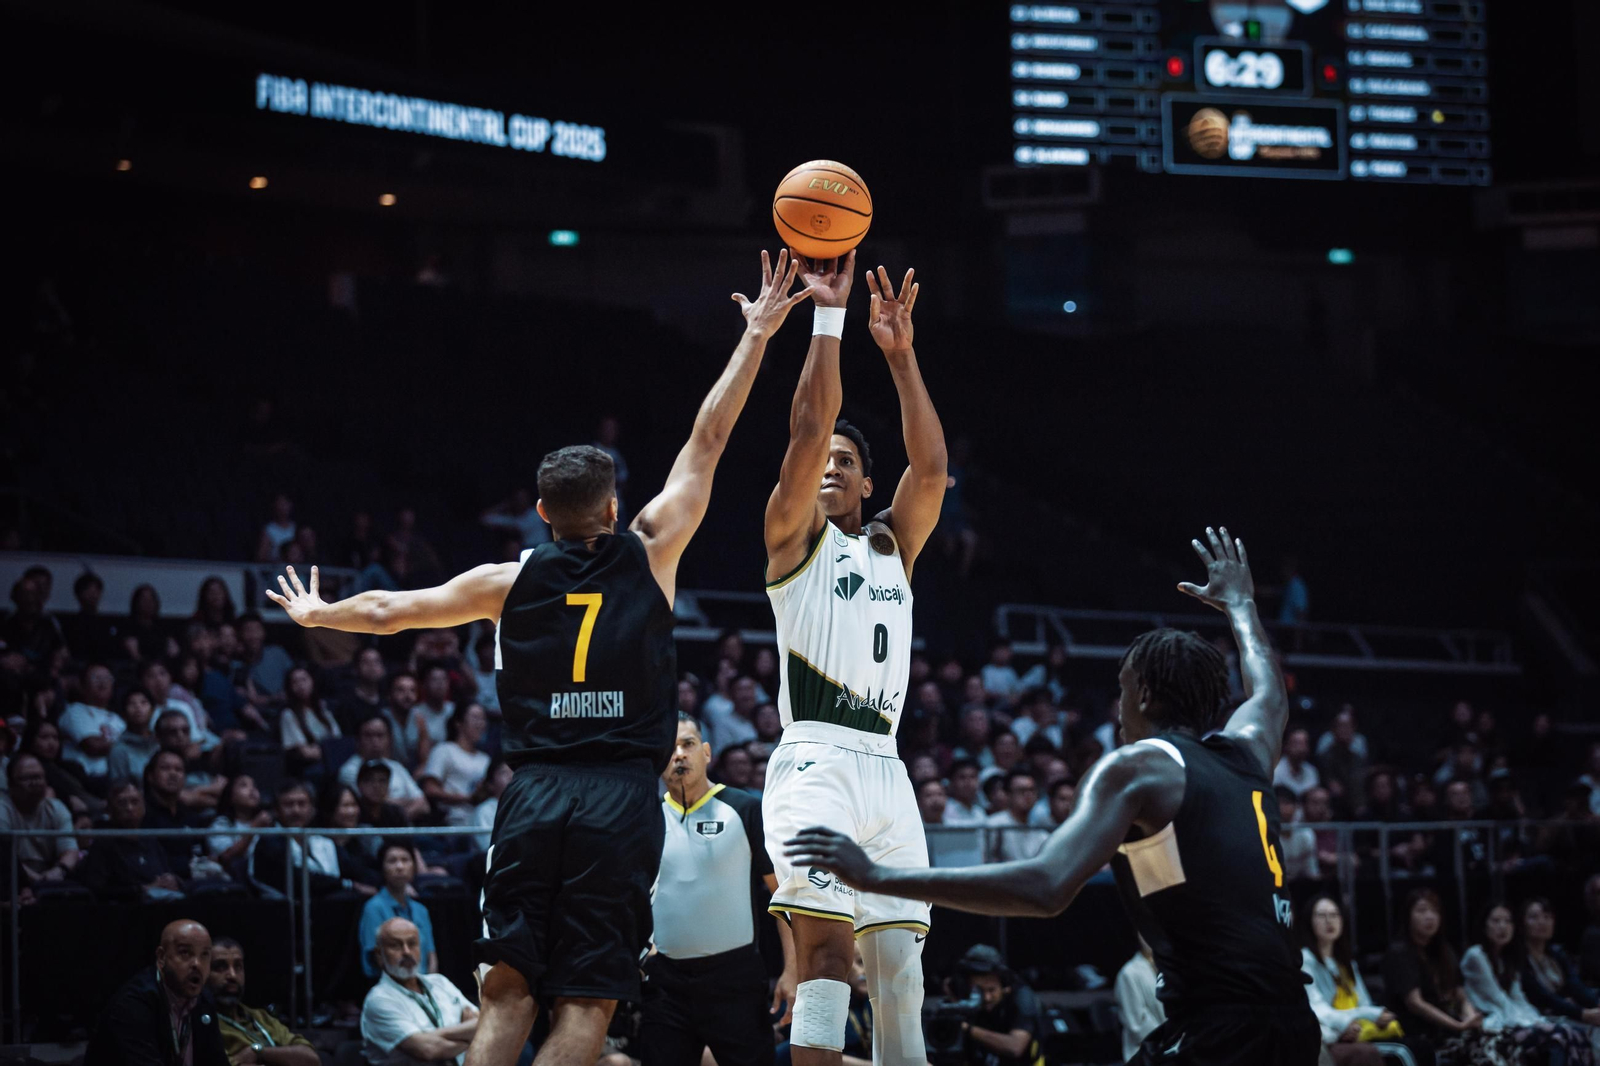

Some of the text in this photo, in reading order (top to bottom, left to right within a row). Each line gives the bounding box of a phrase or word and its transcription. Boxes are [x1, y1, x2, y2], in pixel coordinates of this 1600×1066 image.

[509, 114, 551, 152] CUP
[551, 121, 607, 162] 2025
[808, 178, 848, 195] EVO
[566, 594, 602, 682] 7
[874, 623, 888, 663] 0
[551, 691, 624, 719] BADRUSH
